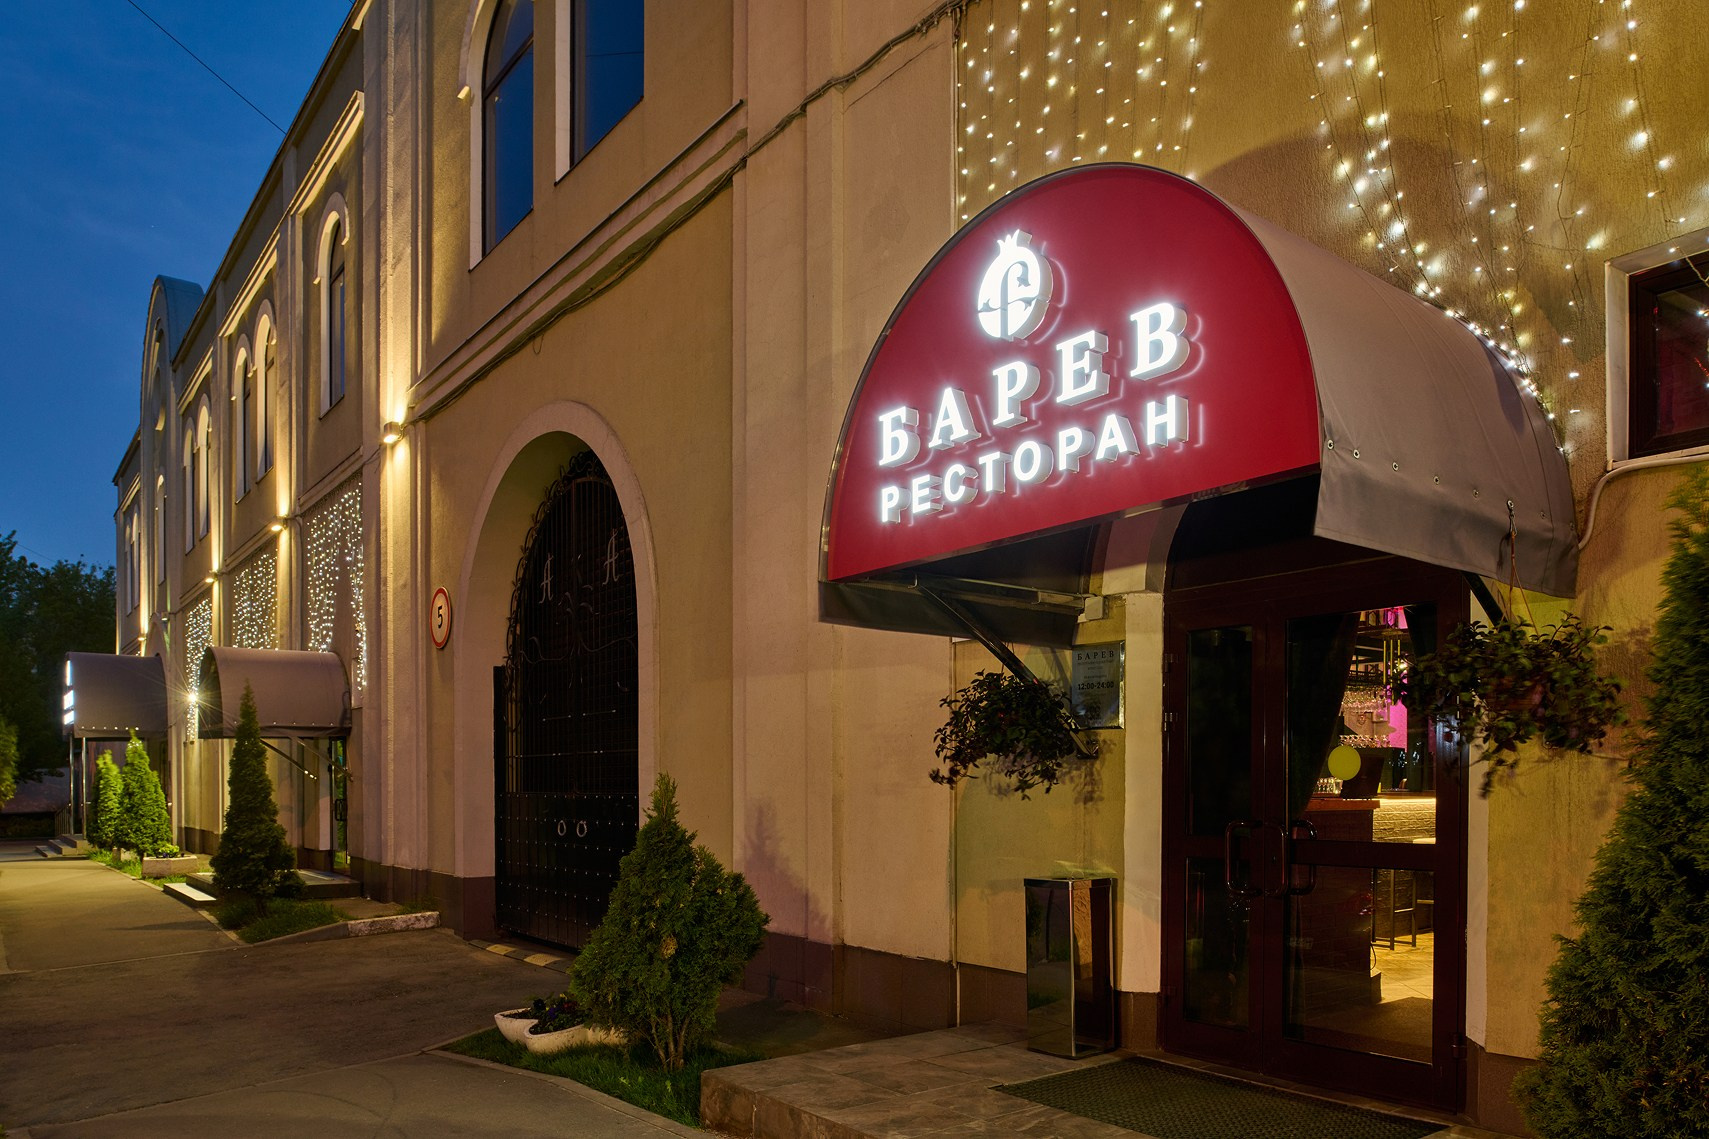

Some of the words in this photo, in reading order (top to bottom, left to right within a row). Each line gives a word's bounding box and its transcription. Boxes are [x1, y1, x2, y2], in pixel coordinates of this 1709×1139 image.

[878, 302, 1188, 466] БАРЕВ
[880, 395, 1187, 524] РЕСТОРАН
[437, 605, 443, 629] 5
[1078, 650, 1114, 660] БАРЕВ
